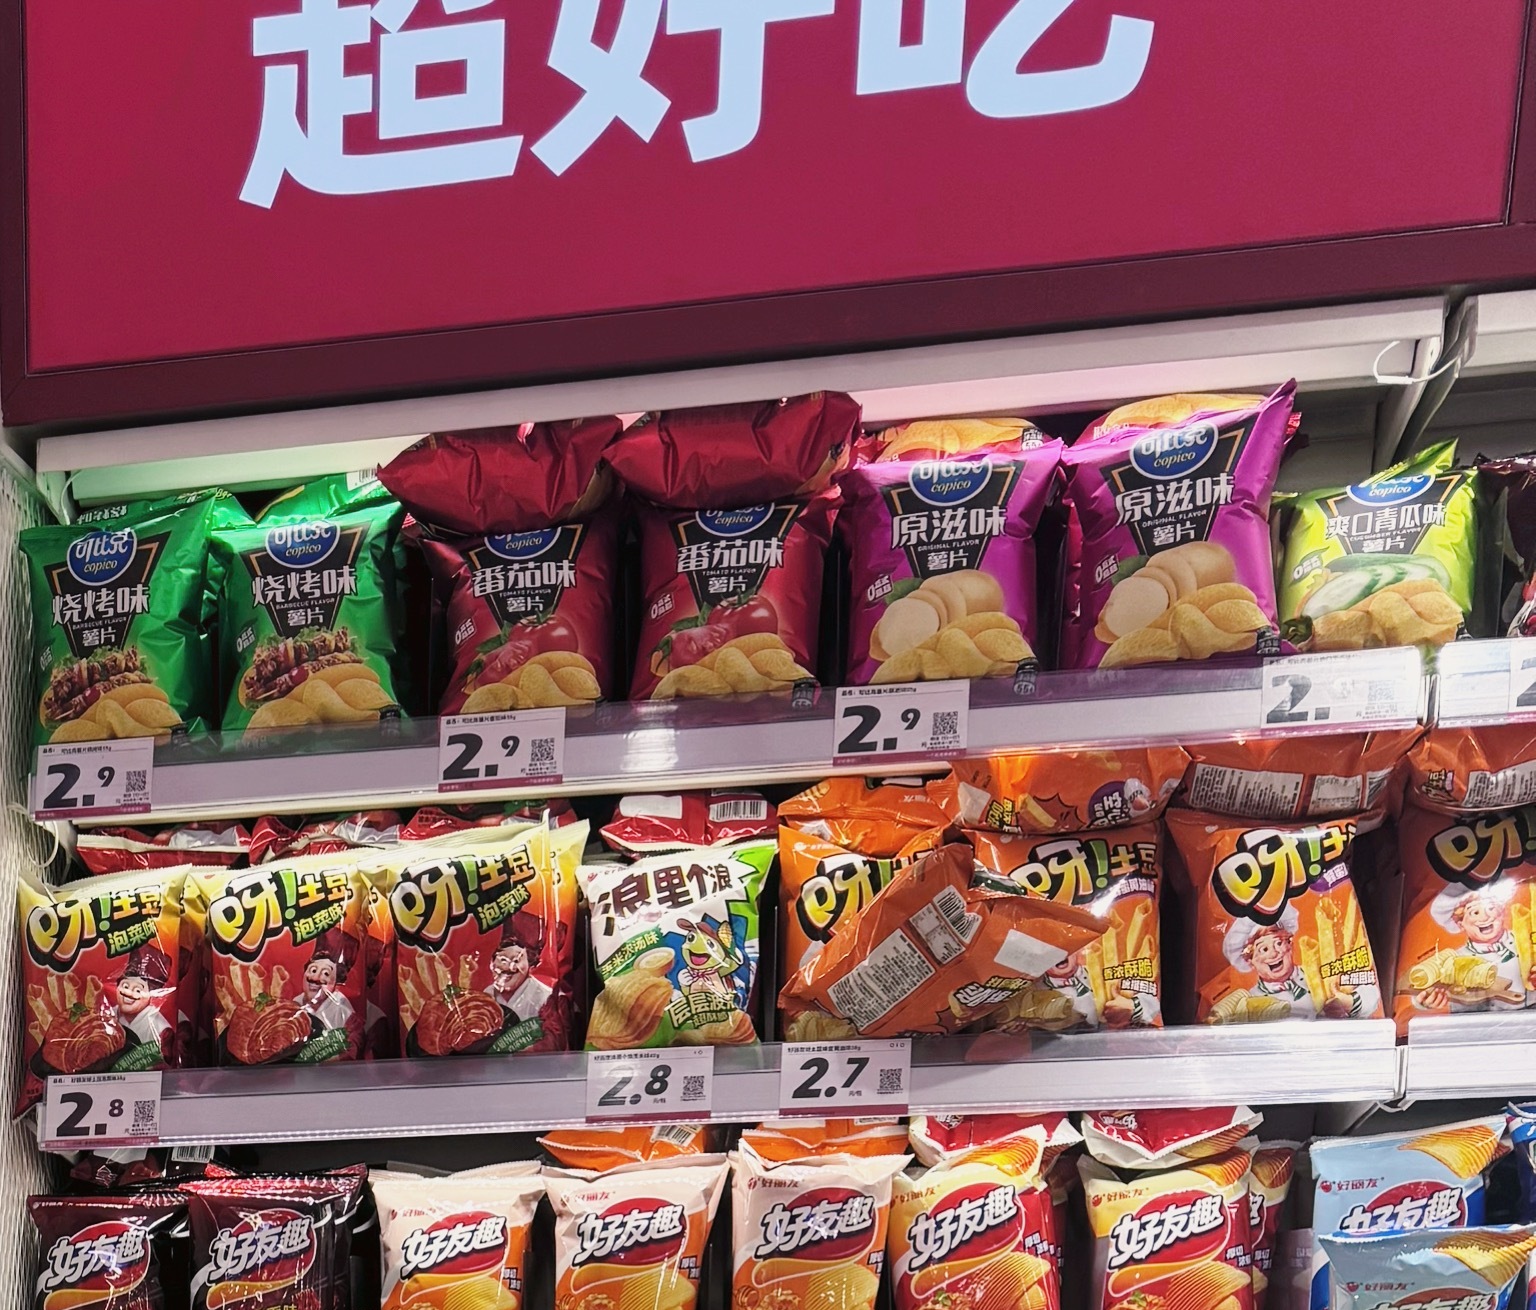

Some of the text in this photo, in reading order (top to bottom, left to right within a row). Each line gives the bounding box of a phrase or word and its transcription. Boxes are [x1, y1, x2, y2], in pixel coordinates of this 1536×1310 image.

[1115, 473, 1234, 527] 原滋味
[1325, 502, 1447, 539] 爽口青瓜味
[890, 505, 1008, 550] 原滋味
[676, 537, 785, 574] 番茄味
[926, 551, 968, 572] 薯片
[252, 565, 359, 607] 烧烤味
[472, 559, 576, 600] 番茄味
[707, 576, 749, 595] 薯片
[52, 583, 150, 626] 烧烤味
[287, 607, 325, 628] 薯片
[82, 626, 118, 648] 薯片
[837, 704, 922, 754] 2.9
[443, 732, 521, 782] 2.9
[43, 764, 116, 811] 2.9
[292, 902, 344, 943] 泡菜味
[477, 885, 529, 934] 泡菜味
[107, 918, 156, 956] 泡菜味
[598, 1064, 672, 1107] 2.8
[792, 1057, 869, 1100] 2.7
[56, 1092, 124, 1137] 2.8
[207, 1215, 312, 1281] 好友趣
[400, 1216, 506, 1281] 好友趣
[572, 1203, 683, 1270] 好友趣
[756, 1194, 874, 1263] 好友趣
[907, 1184, 1020, 1273] 好友趣
[1109, 1195, 1225, 1269] 好友趣
[43, 1225, 149, 1291] 好友趣
